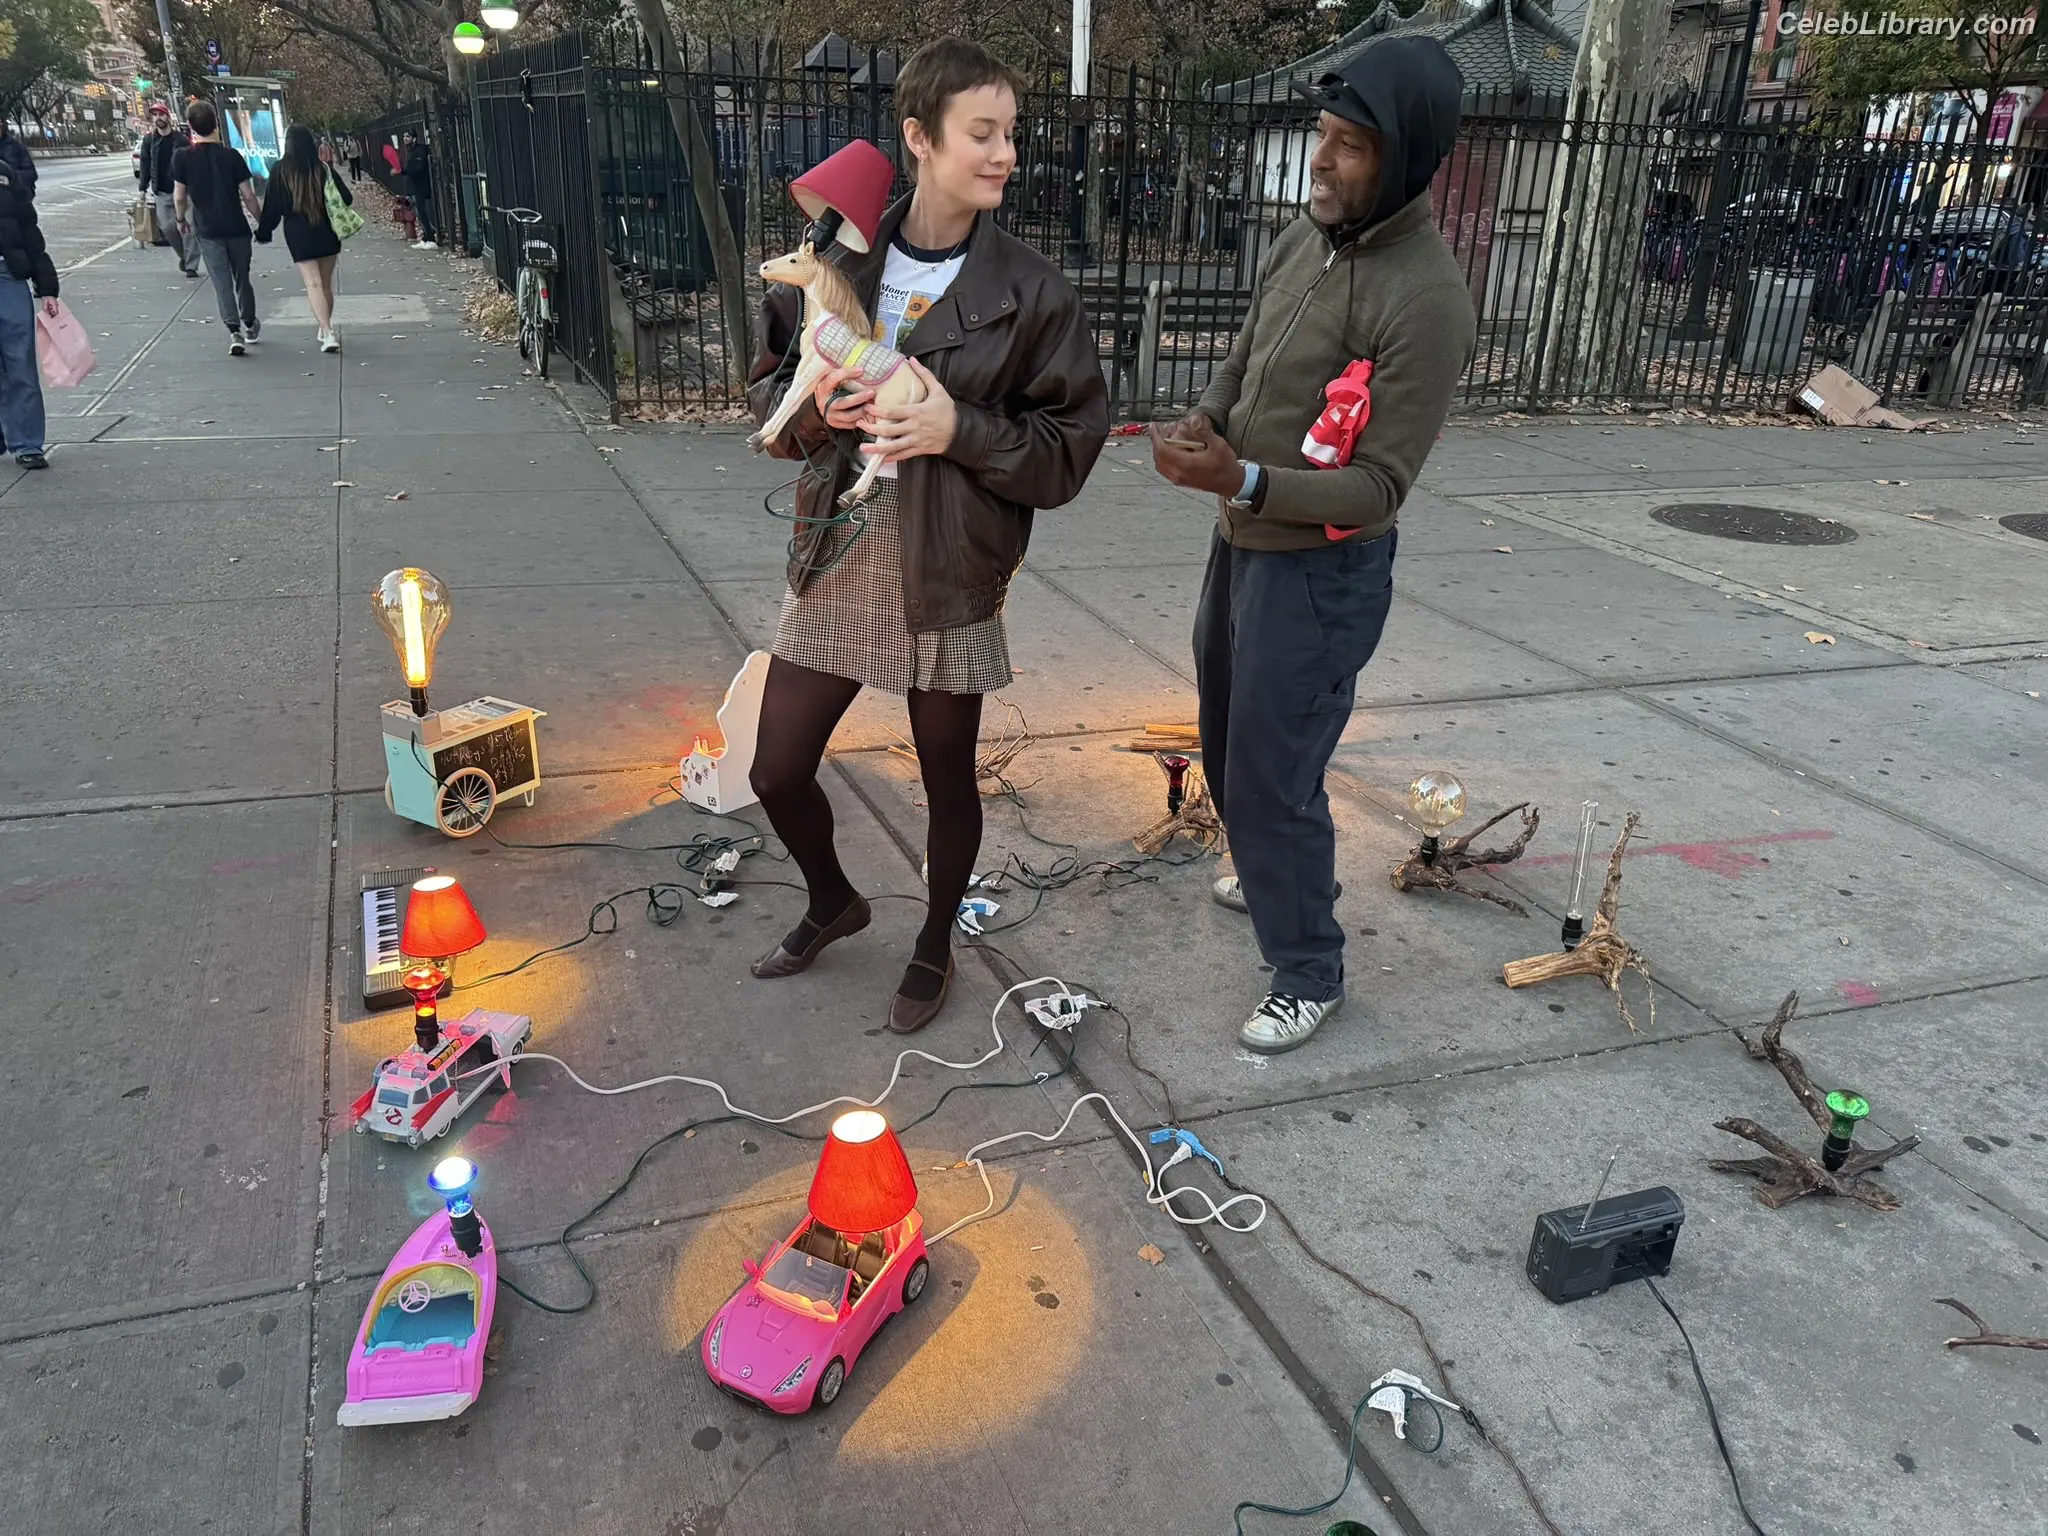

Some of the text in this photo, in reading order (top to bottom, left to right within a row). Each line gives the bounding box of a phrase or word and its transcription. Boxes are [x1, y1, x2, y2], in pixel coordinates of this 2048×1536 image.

[607, 195, 645, 205] Staion
[881, 283, 909, 297] Monet
[880, 291, 905, 301] RANCE
